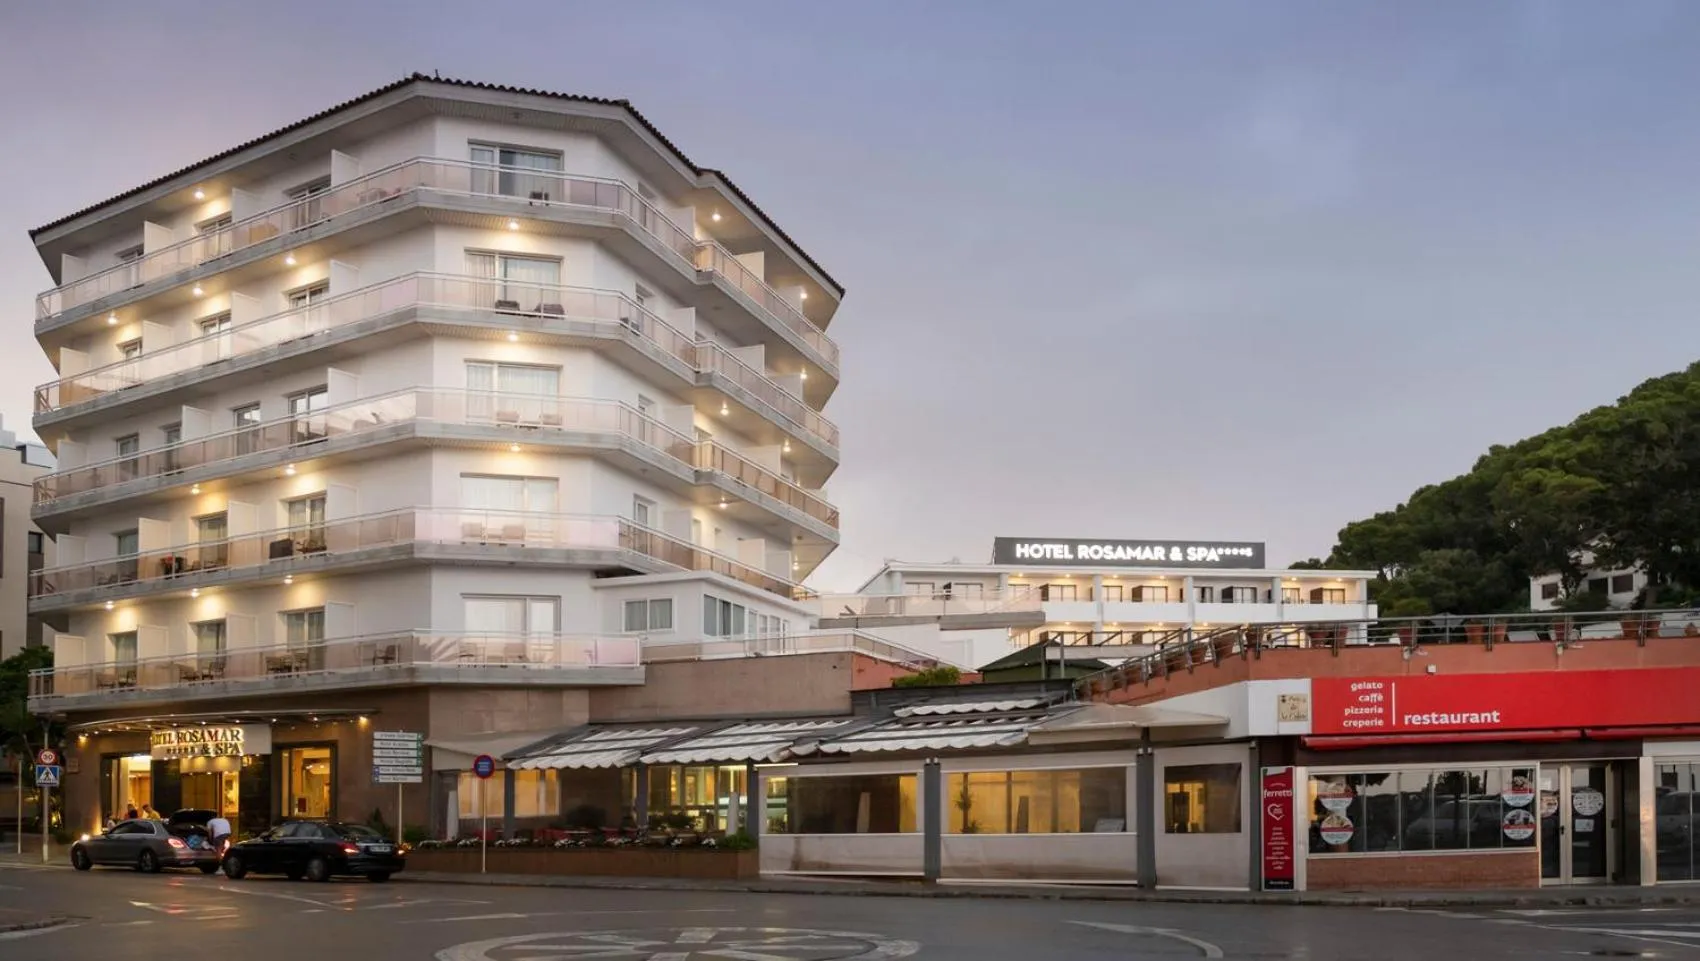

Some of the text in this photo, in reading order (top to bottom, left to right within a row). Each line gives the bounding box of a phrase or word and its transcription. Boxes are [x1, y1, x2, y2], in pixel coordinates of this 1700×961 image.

[1015, 543, 1073, 560] HOTEL
[1077, 544, 1166, 561] ROSAMAR
[1169, 546, 1183, 561] &
[1350, 681, 1383, 692] gelato
[1344, 705, 1384, 716] pizzeria
[1343, 717, 1384, 728] creperie
[1404, 709, 1500, 726] restaurant
[177, 728, 243, 744] ROSAMAR
[200, 742, 242, 756] & SPA
[1263, 789, 1292, 799] ferretti
